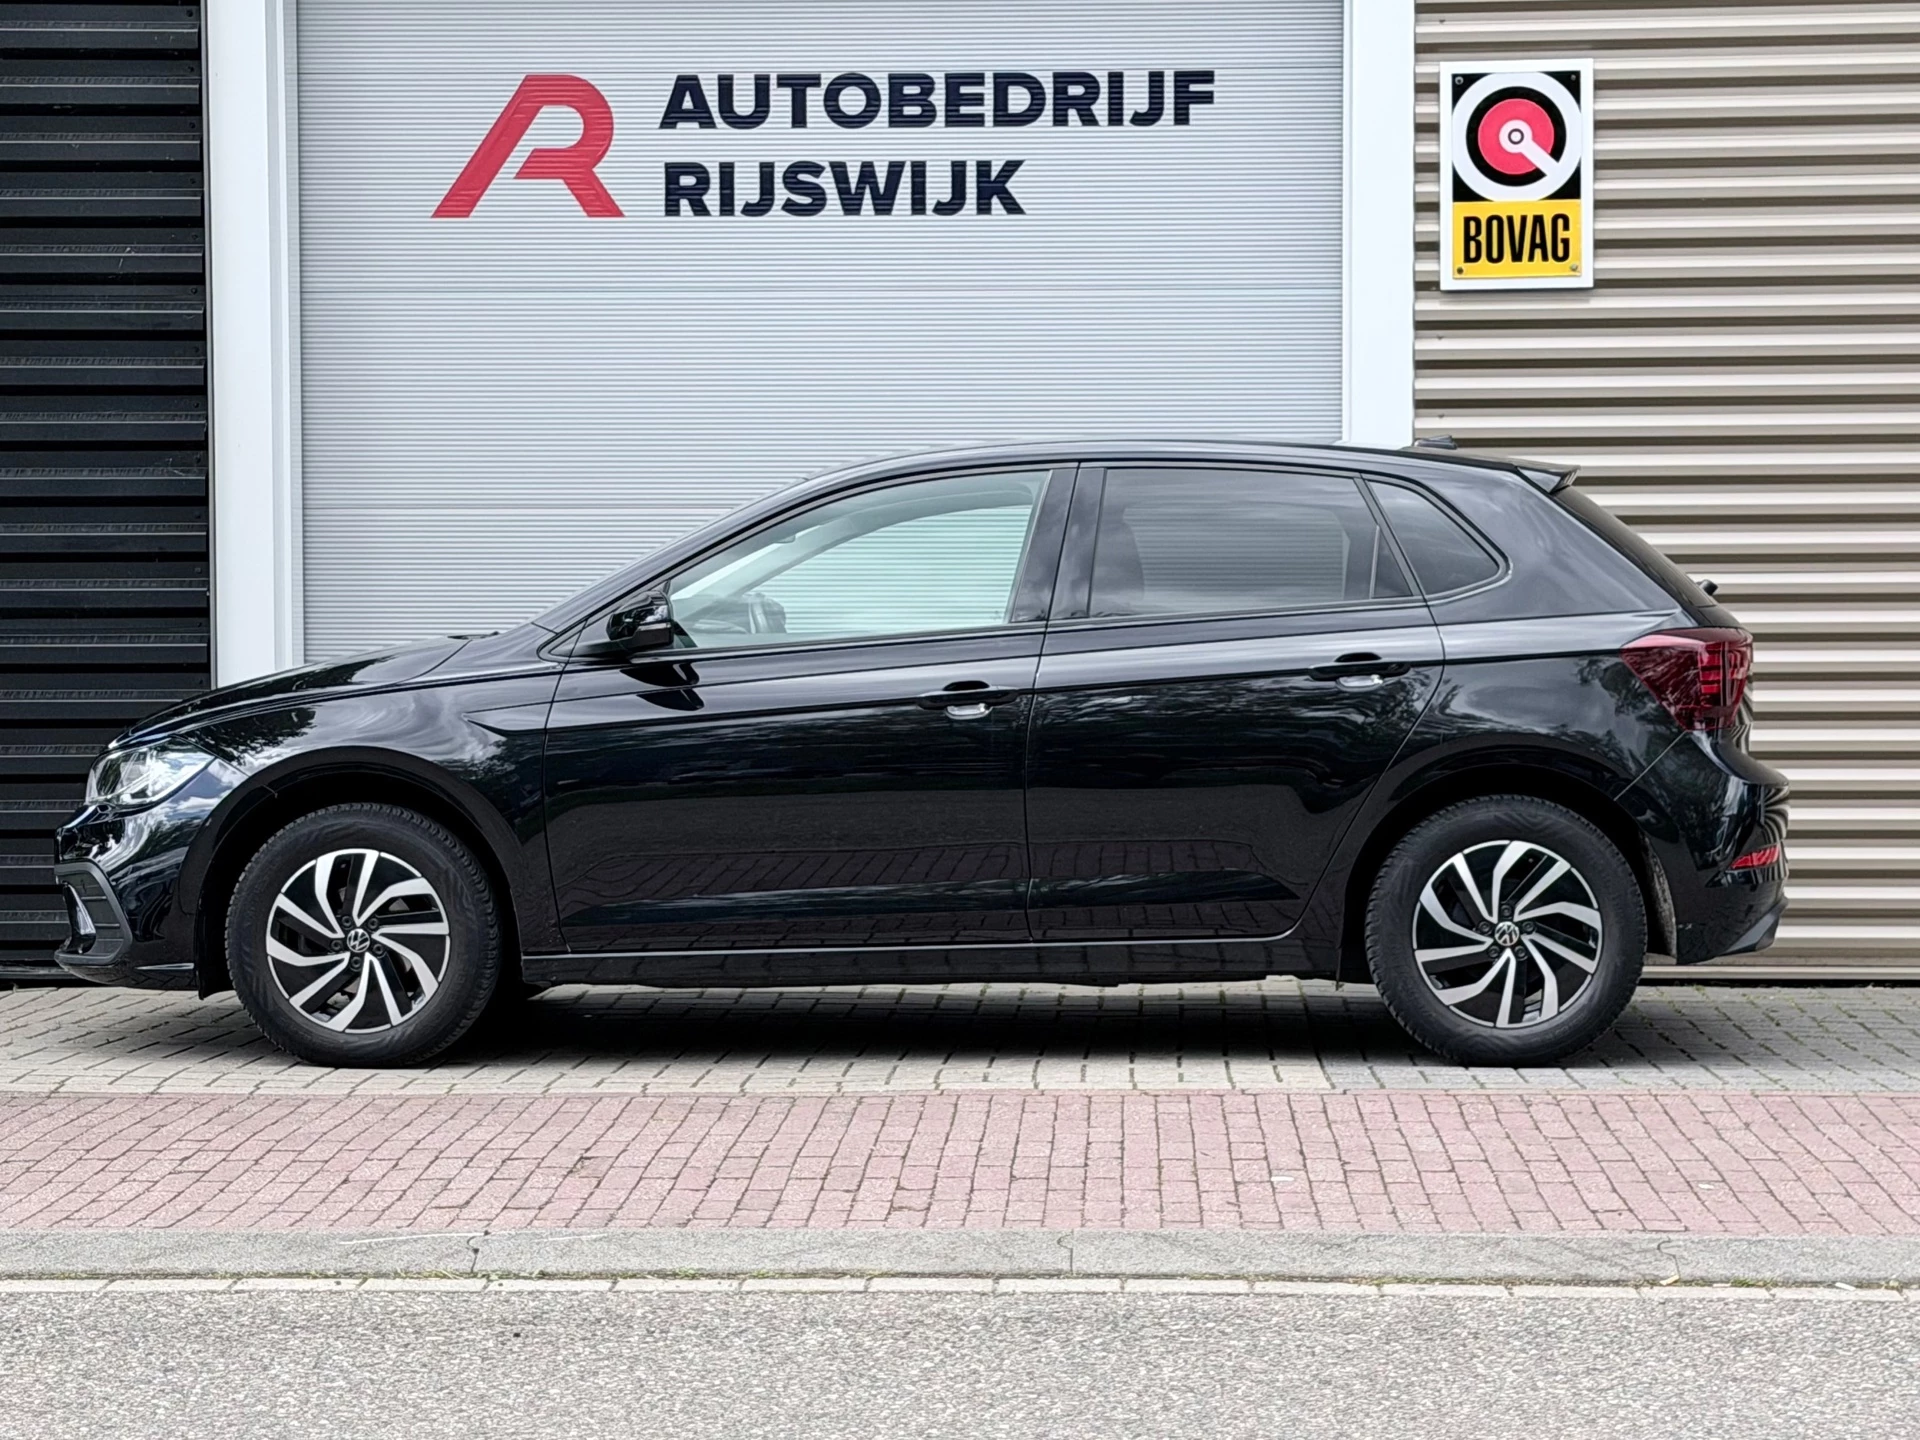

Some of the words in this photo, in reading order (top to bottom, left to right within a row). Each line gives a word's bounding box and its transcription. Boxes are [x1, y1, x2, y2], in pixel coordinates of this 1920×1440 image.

[659, 70, 1215, 130] AUTOBEDRIJF
[664, 160, 1025, 217] RIJSWIJK
[1463, 213, 1570, 263] BOVAG
